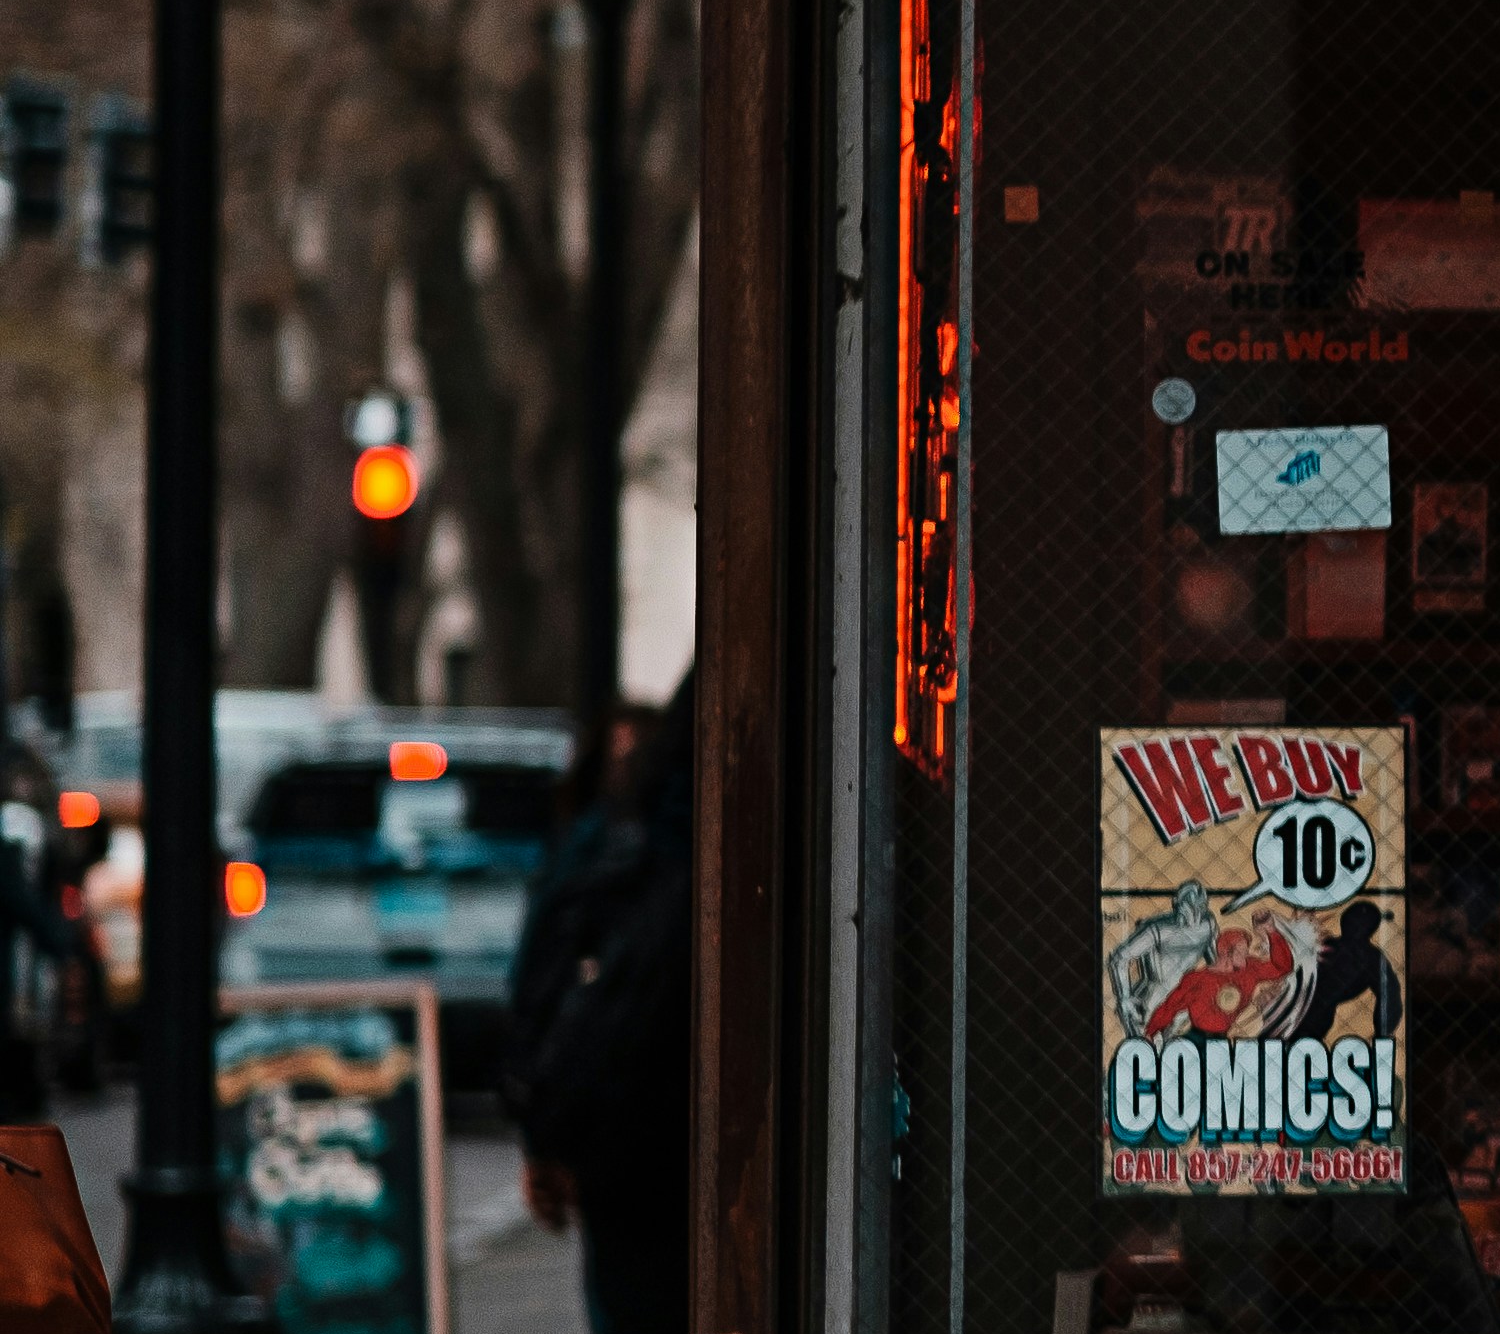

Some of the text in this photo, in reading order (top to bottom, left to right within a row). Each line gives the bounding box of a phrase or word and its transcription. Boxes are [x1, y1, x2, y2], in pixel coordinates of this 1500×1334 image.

[1196, 251, 1250, 278] ON
[1185, 329, 1409, 363] Coin World
[1115, 732, 1365, 845] WE BUY
[1109, 1037, 1396, 1144] COMICS!
[1113, 1148, 1181, 1184] CALL
